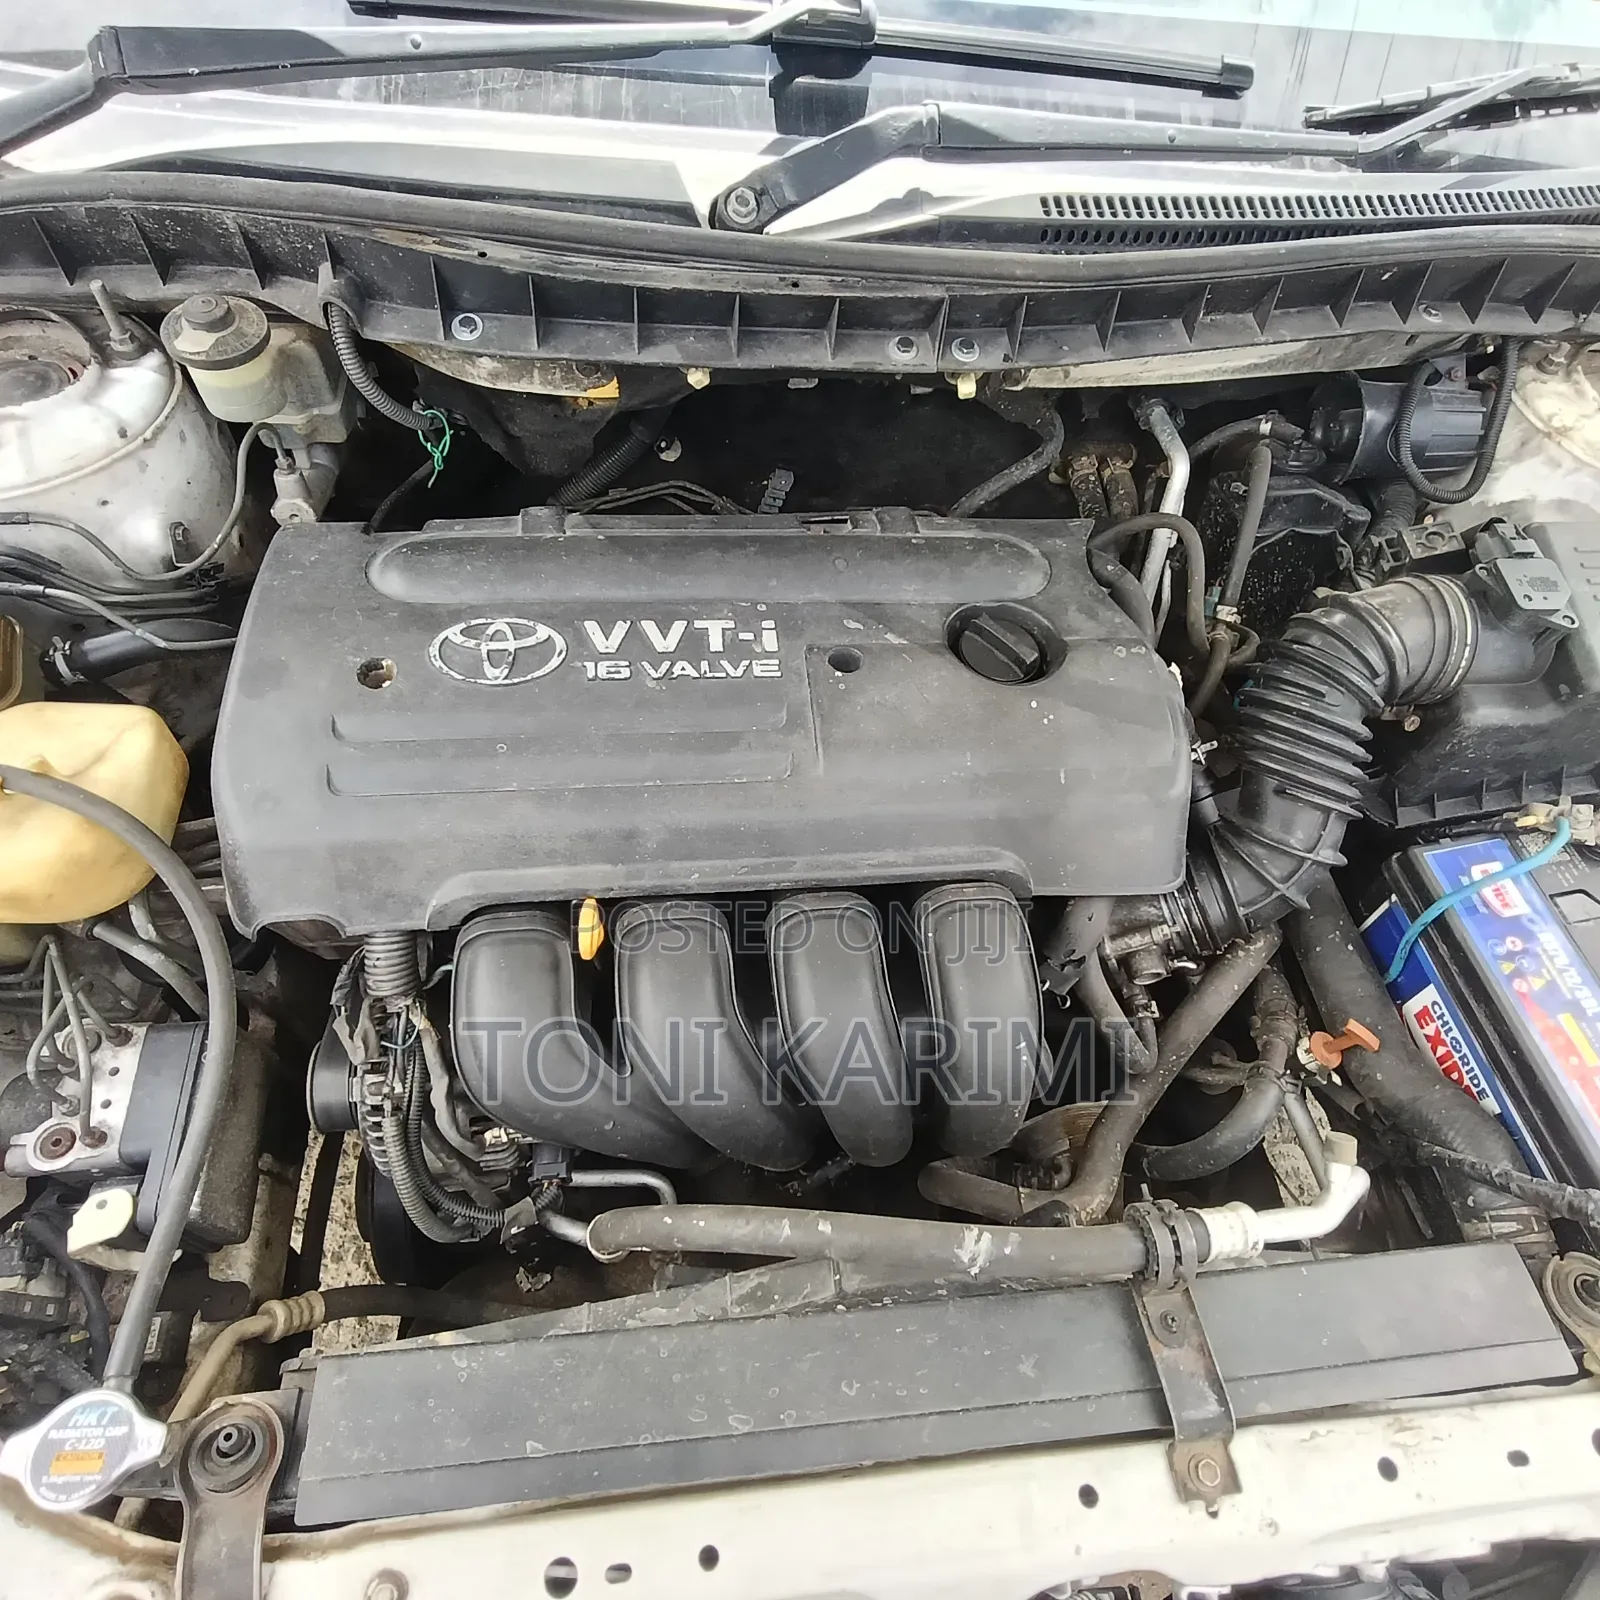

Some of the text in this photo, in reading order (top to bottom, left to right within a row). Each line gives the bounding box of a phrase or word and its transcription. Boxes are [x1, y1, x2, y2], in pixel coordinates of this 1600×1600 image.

[583, 619, 780, 653] VVT-i
[583, 660, 783, 681] 16 VALVE
[1430, 1000, 1490, 1102] CHLORIDE
[68, 1406, 120, 1427] HKT
[48, 1427, 101, 1440] RADIATOR
